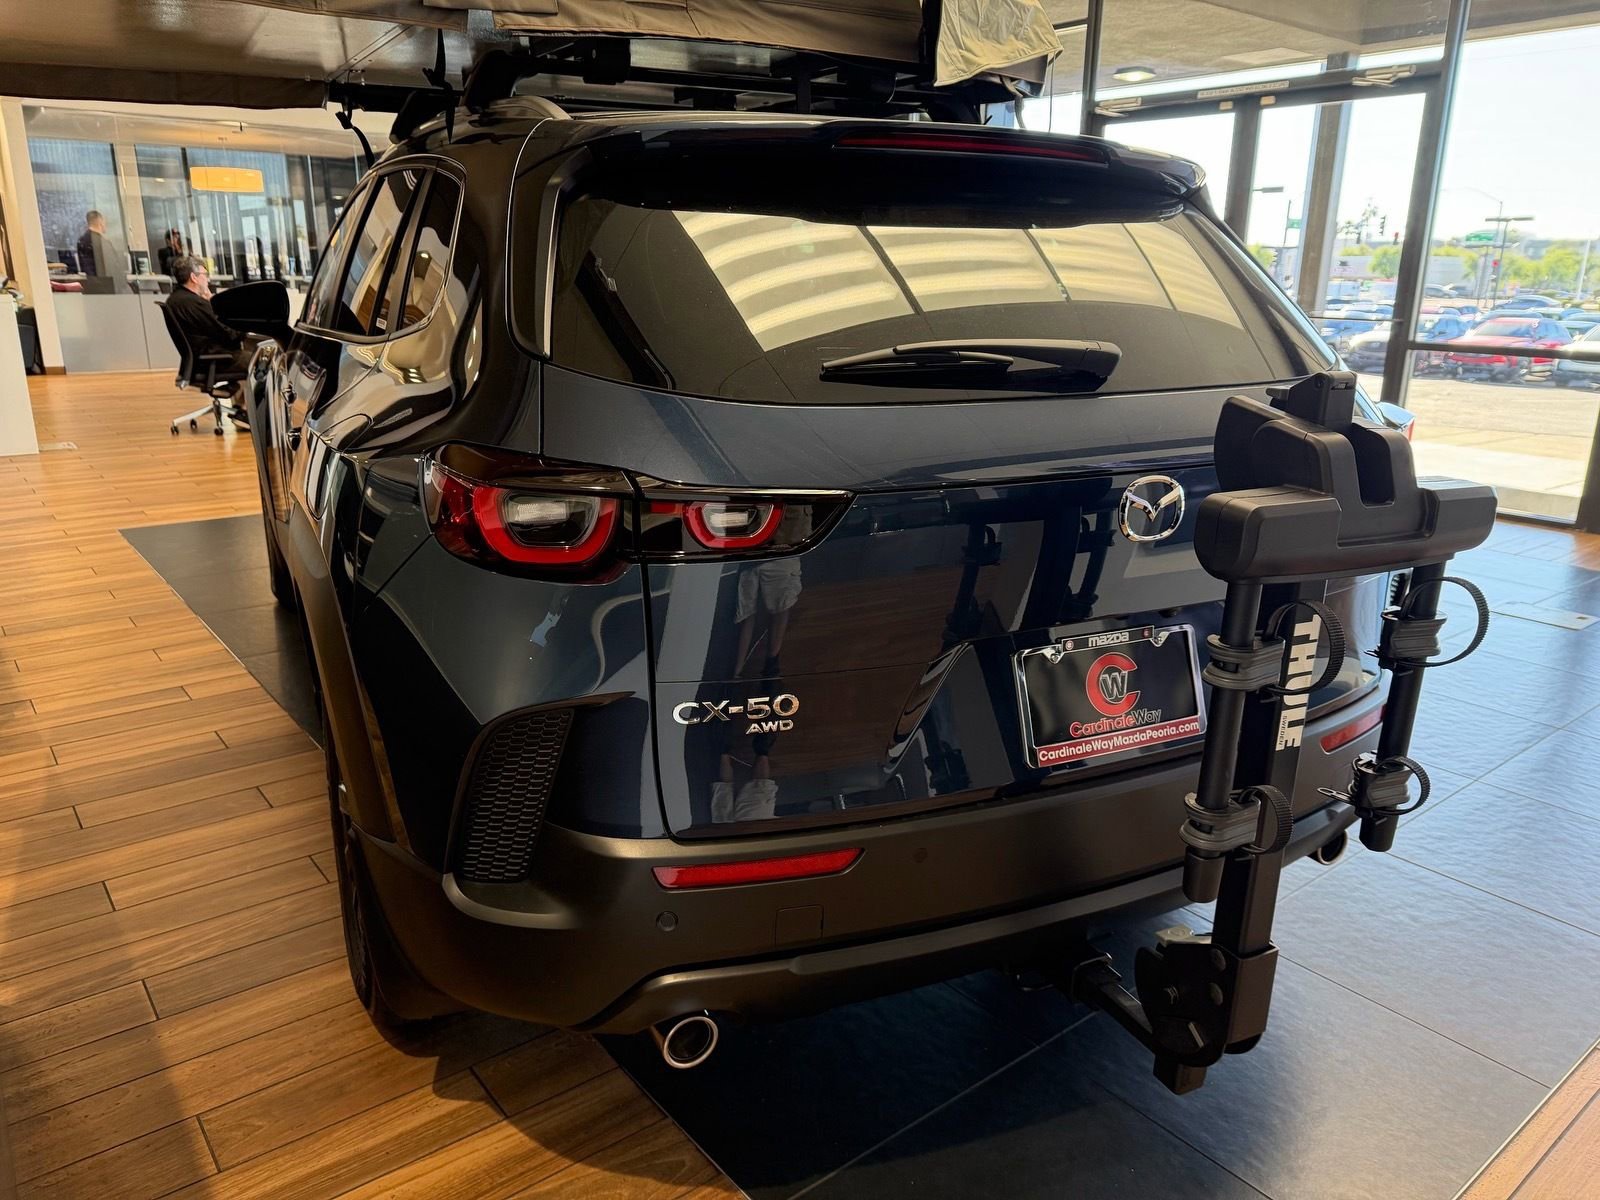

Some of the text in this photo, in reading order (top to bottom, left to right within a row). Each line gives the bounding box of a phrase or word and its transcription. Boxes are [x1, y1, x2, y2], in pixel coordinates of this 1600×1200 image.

[1088, 632, 1130, 647] mazda
[1275, 614, 1322, 751] THULE
[672, 693, 800, 725] CX-50
[745, 719, 794, 735] AWD
[1039, 721, 1200, 762] CardinaleWayMazdaPeoria.com
[1278, 715, 1288, 746] SWEDEN
